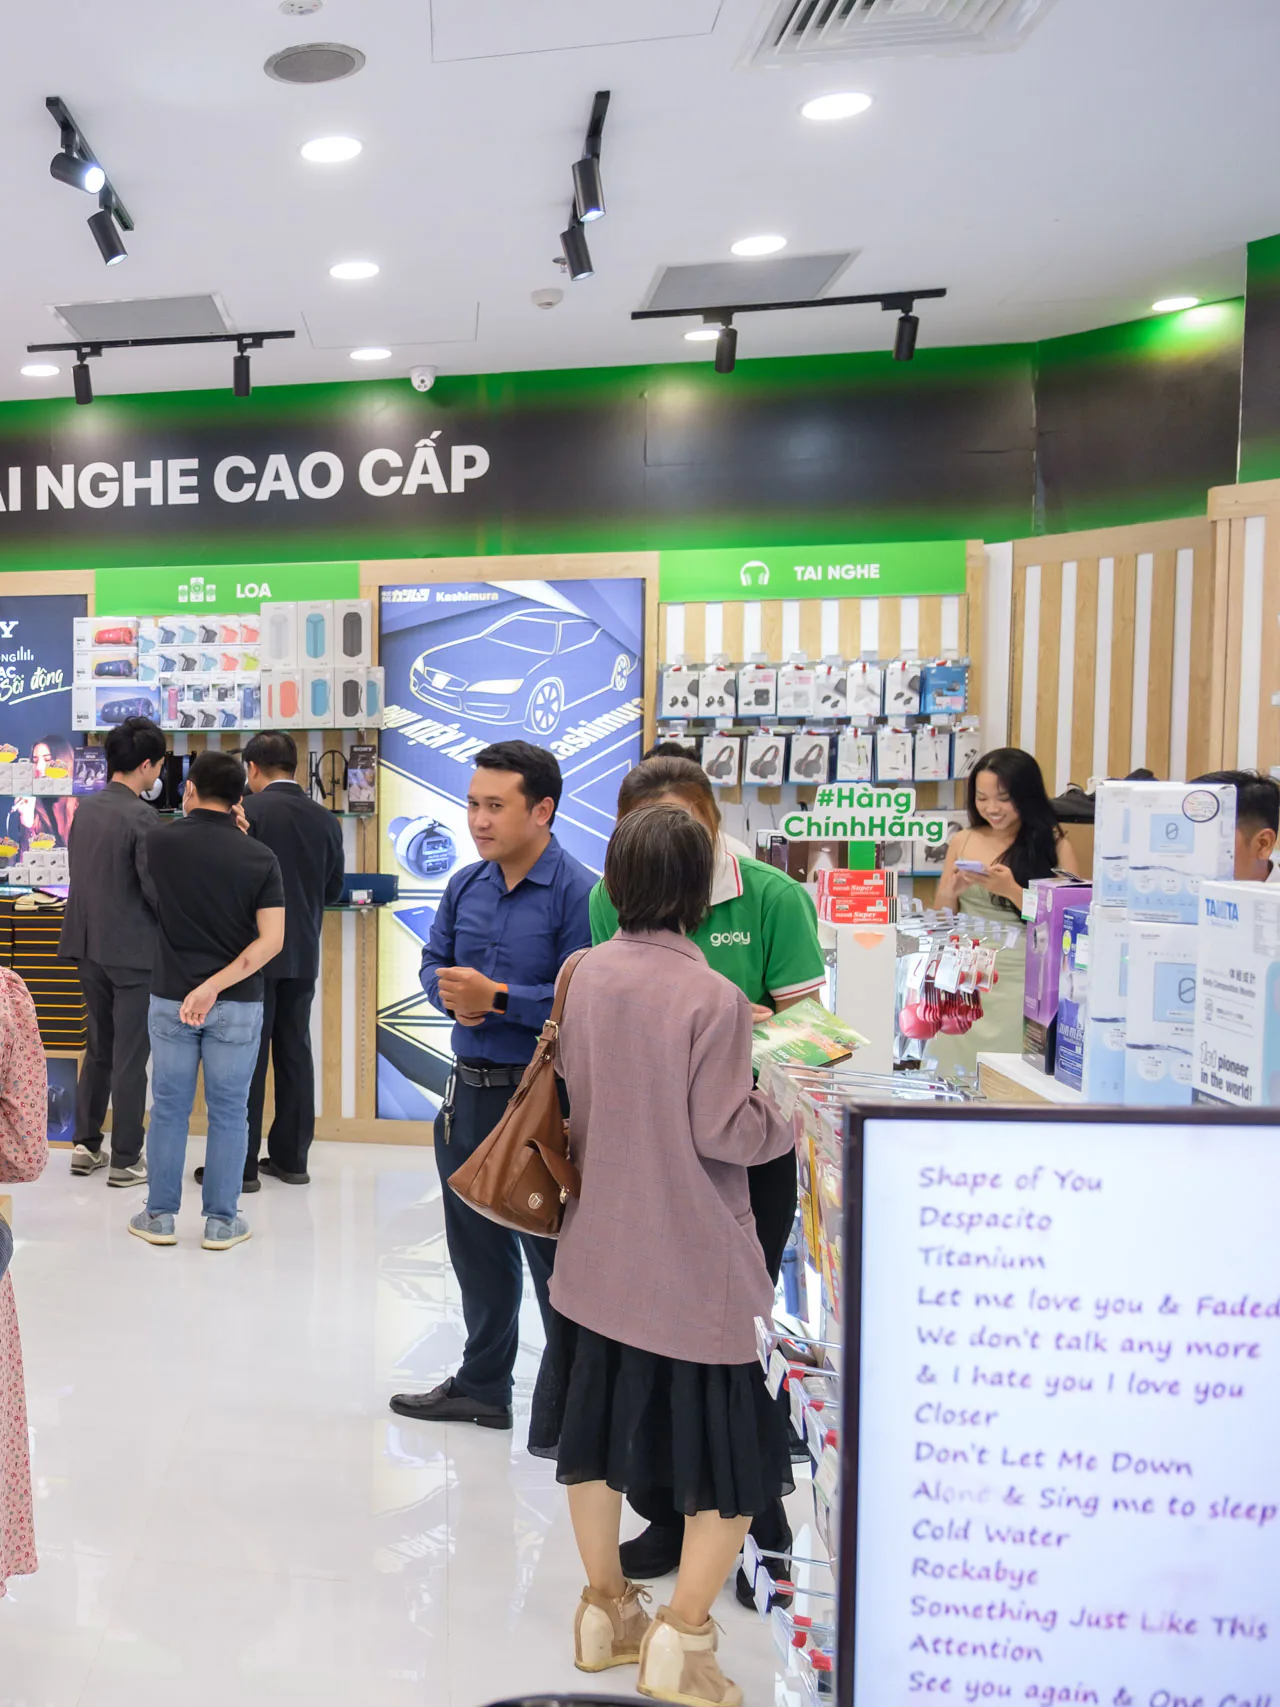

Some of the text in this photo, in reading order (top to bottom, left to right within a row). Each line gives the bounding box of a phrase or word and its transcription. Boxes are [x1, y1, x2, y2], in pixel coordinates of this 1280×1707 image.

[36, 457, 199, 509] NGHE
[213, 449, 343, 503] CAO
[358, 430, 490, 497] CẤP
[794, 563, 880, 581] TAI NGHE
[236, 583, 272, 598] LOA
[436, 591, 499, 602] Kashimura
[817, 787, 911, 813] #Hàng
[784, 816, 944, 843] ChínhHãng
[710, 930, 750, 947] gojoy
[1217, 1054, 1249, 1078] pioneer
[1200, 1067, 1253, 1102] in the world!
[918, 1165, 1103, 1197] Shape of You
[919, 1206, 1053, 1235] Despacito
[918, 1246, 1047, 1270] Titanium
[918, 1286, 1280, 1321] Let me love you & Faded
[917, 1325, 1262, 1363] We don't talk any more
[916, 1364, 937, 1385] &
[972, 1365, 1032, 1389] hate
[1045, 1374, 1094, 1397] you
[1128, 1371, 1181, 1396] love
[1195, 1380, 1245, 1404] you
[915, 1401, 999, 1427] Closer
[915, 1441, 1194, 1477] Don't Let Me Down
[1003, 1485, 1025, 1506] &
[1040, 1485, 1099, 1518] Sing
[1113, 1497, 1155, 1515] me
[1168, 1496, 1196, 1516] to
[1209, 1496, 1278, 1527] sleep
[912, 1517, 1072, 1548] Cold Water
[911, 1556, 1039, 1591] Rockabye
[910, 1595, 1269, 1641] Something Just Like This
[909, 1634, 1043, 1663] Attention
[909, 1671, 952, 1692] See
[965, 1679, 1012, 1703] you
[1025, 1681, 1099, 1707] again
[1149, 1689, 1204, 1707] One
